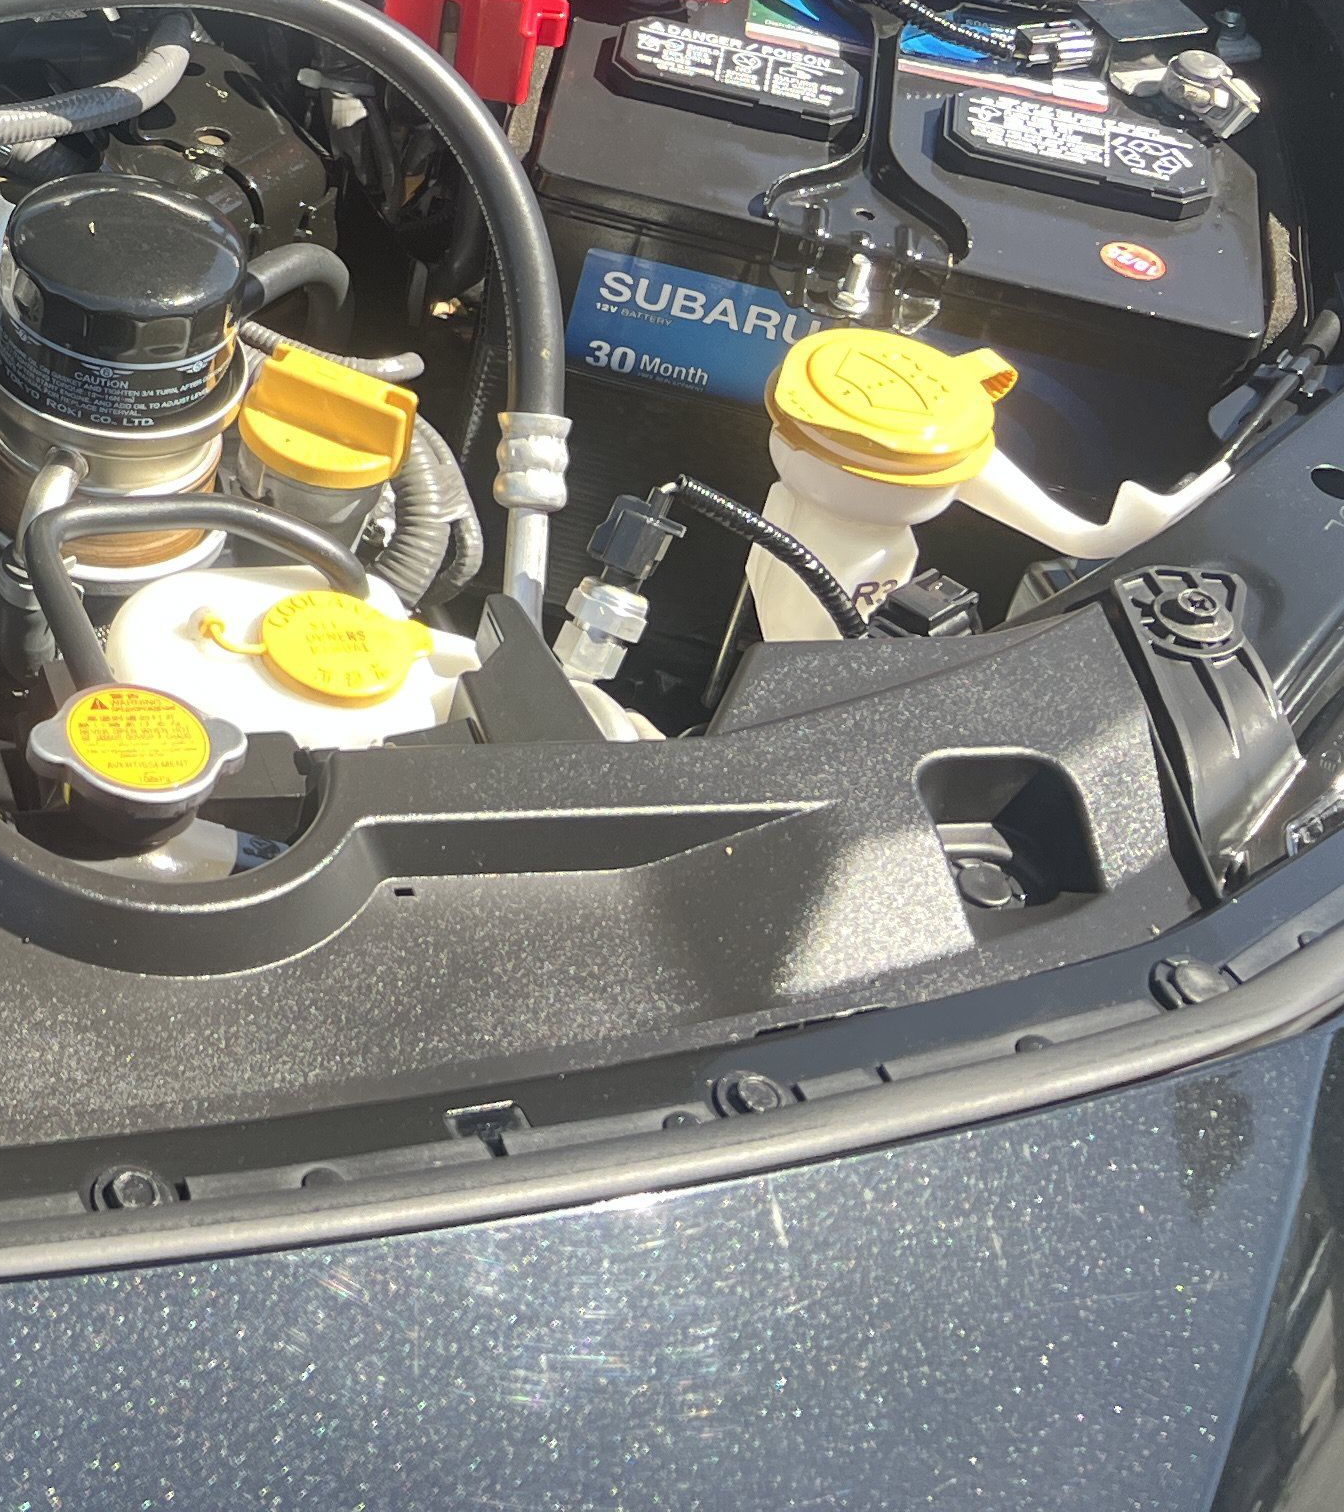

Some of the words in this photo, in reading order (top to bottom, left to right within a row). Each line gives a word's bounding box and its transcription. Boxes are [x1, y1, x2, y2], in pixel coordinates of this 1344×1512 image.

[667, 27, 743, 50] DANGER
[761, 45, 831, 68] POISON
[595, 302, 618, 313] 12V
[620, 307, 673, 327] BATTERY
[598, 271, 822, 346] SUBARU
[74, 371, 130, 390] CAUTION
[585, 340, 637, 374] 30
[639, 354, 709, 386] Month
[4, 367, 41, 400] TOKYO
[46, 398, 82, 418] ROKI
[104, 387, 140, 398] TIGHTEN
